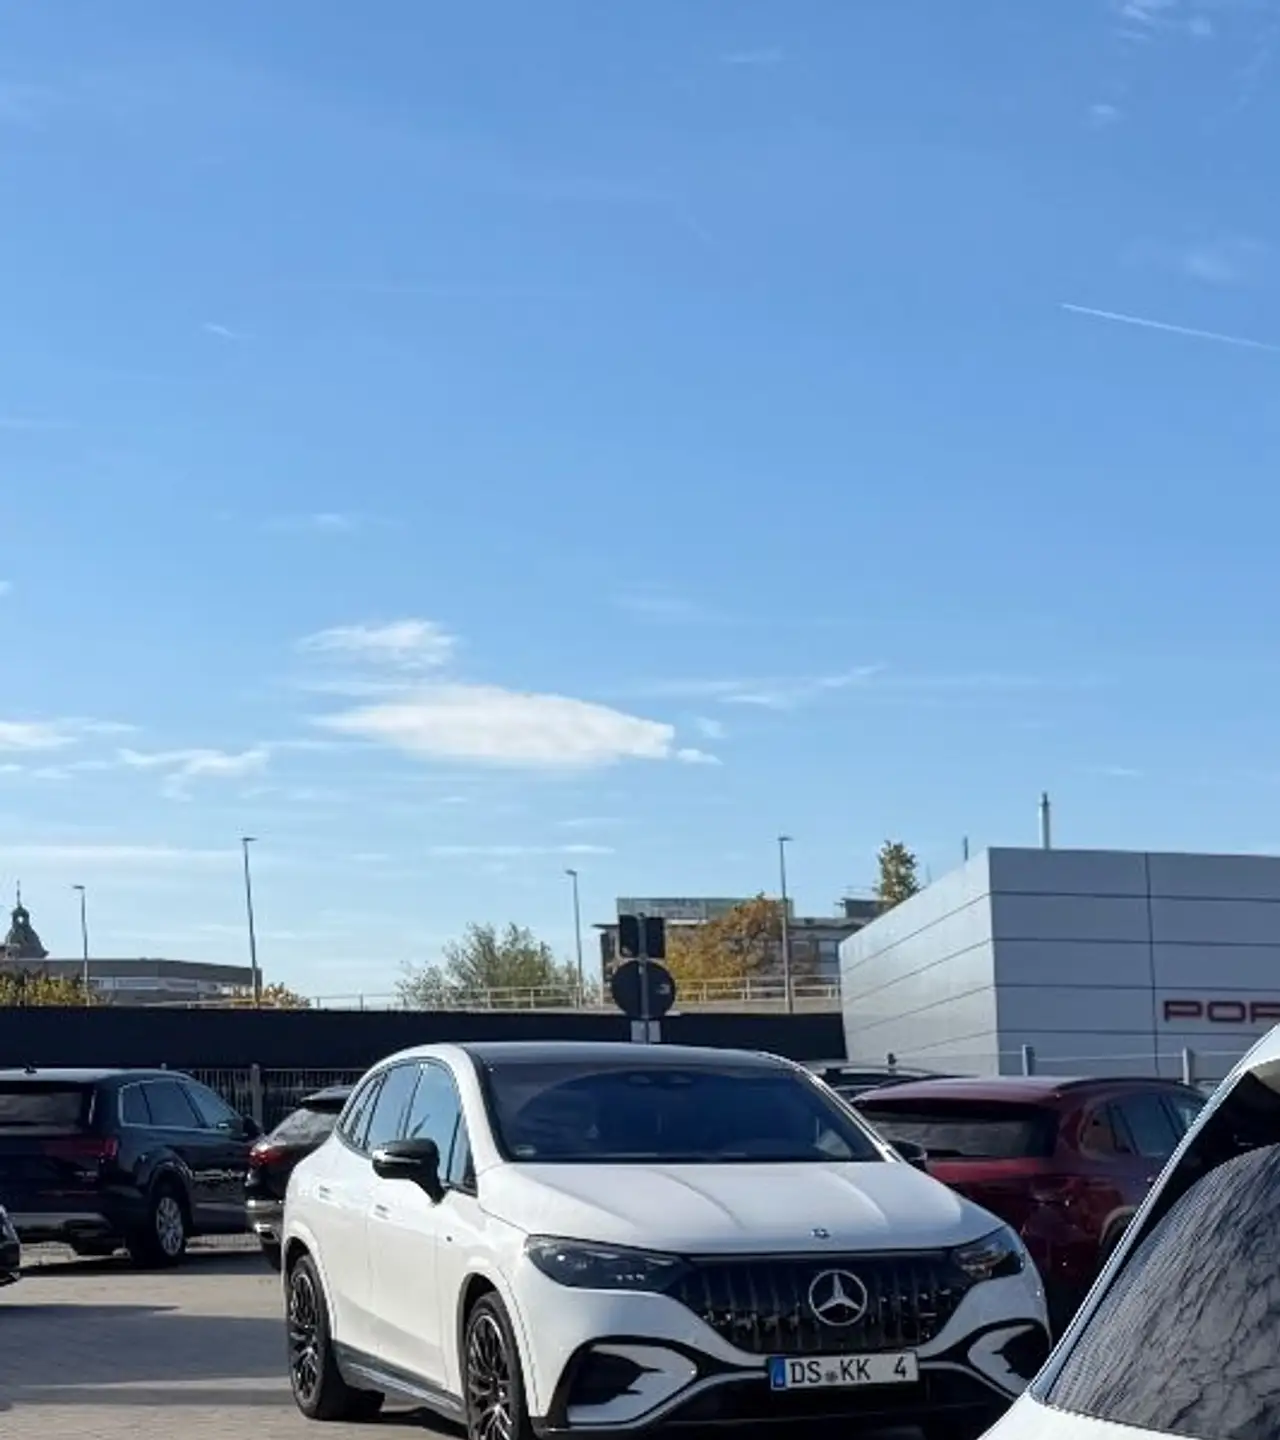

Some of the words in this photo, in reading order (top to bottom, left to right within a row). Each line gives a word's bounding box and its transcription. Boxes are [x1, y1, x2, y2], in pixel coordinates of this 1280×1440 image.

[790, 1361, 821, 1384] DS
[840, 1358, 871, 1382] KK
[893, 1356, 907, 1379] 4
